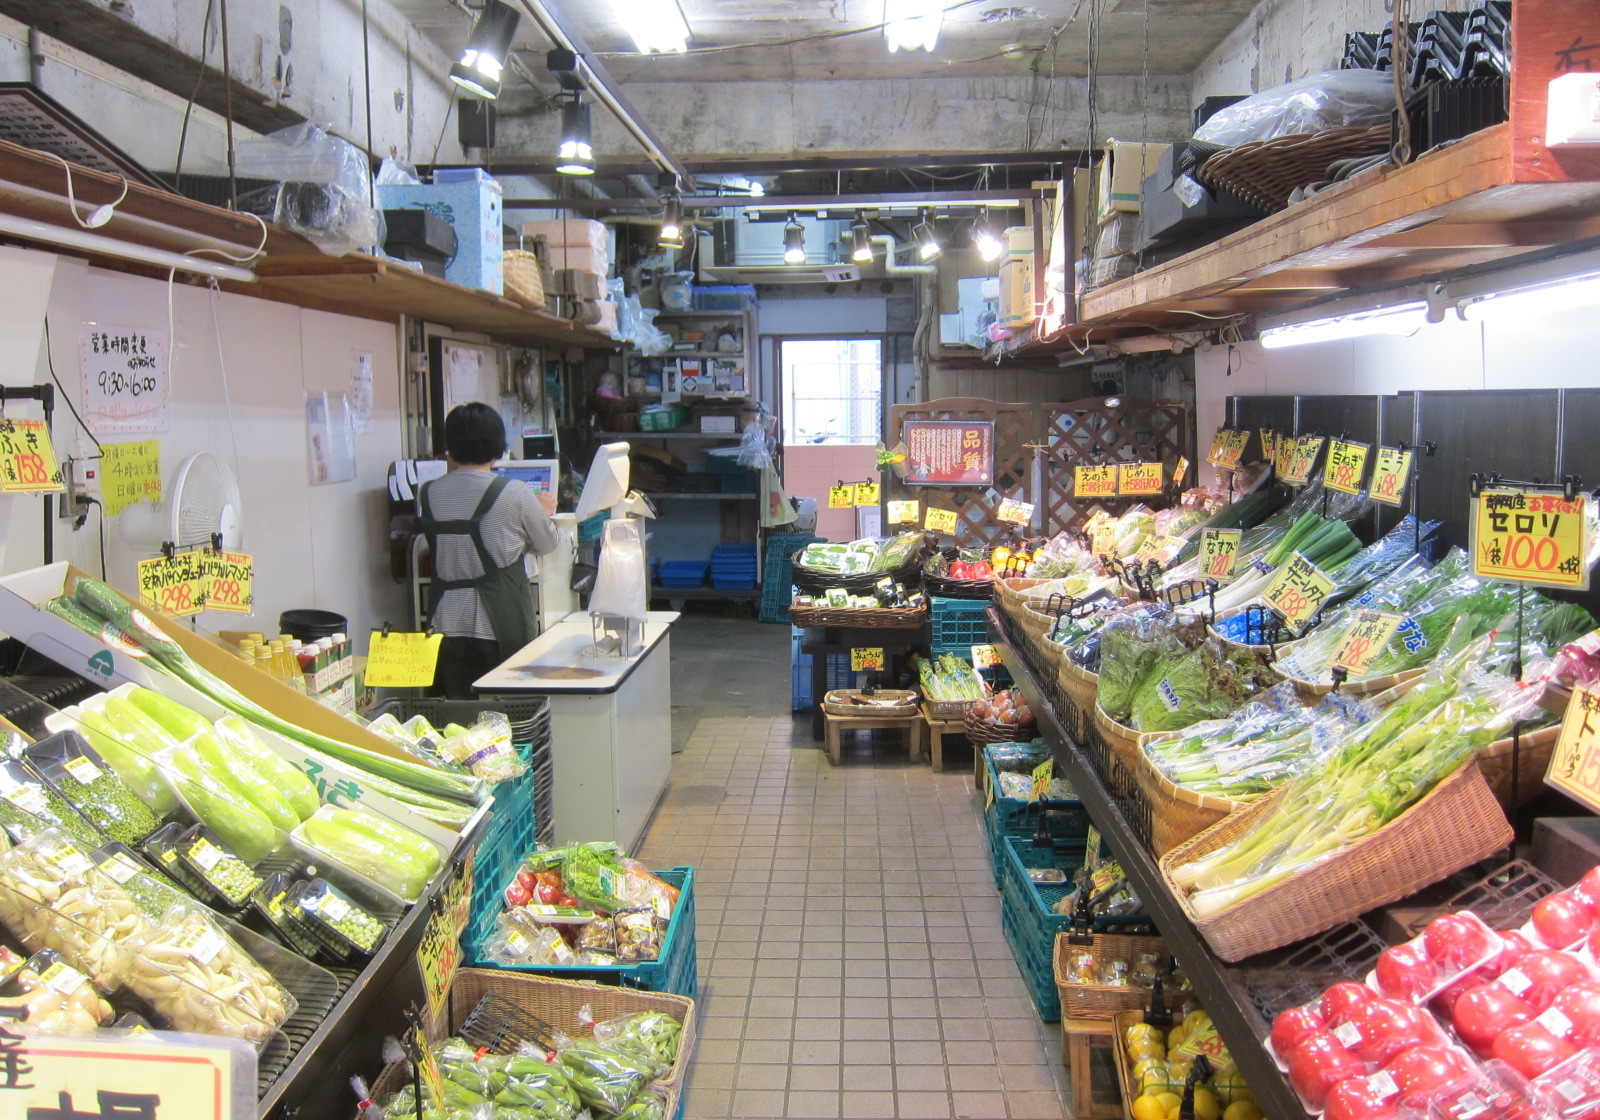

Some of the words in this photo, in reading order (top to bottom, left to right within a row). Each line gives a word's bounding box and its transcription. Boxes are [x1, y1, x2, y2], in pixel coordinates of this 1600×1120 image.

[962, 429, 982, 472] 品質
[13, 453, 49, 484] 158
[1082, 470, 1109, 481] えのき
[1126, 468, 1156, 479] しめじ
[1335, 465, 1355, 487] 198
[1382, 473, 1397, 497] 68
[1488, 509, 1561, 538] セロリ
[1206, 539, 1239, 555] なすび
[1501, 535, 1560, 571] 100
[161, 583, 193, 612] 298
[212, 579, 241, 605] 298
[1286, 565, 1327, 607] サニーレタス
[1276, 587, 1310, 619] 138
